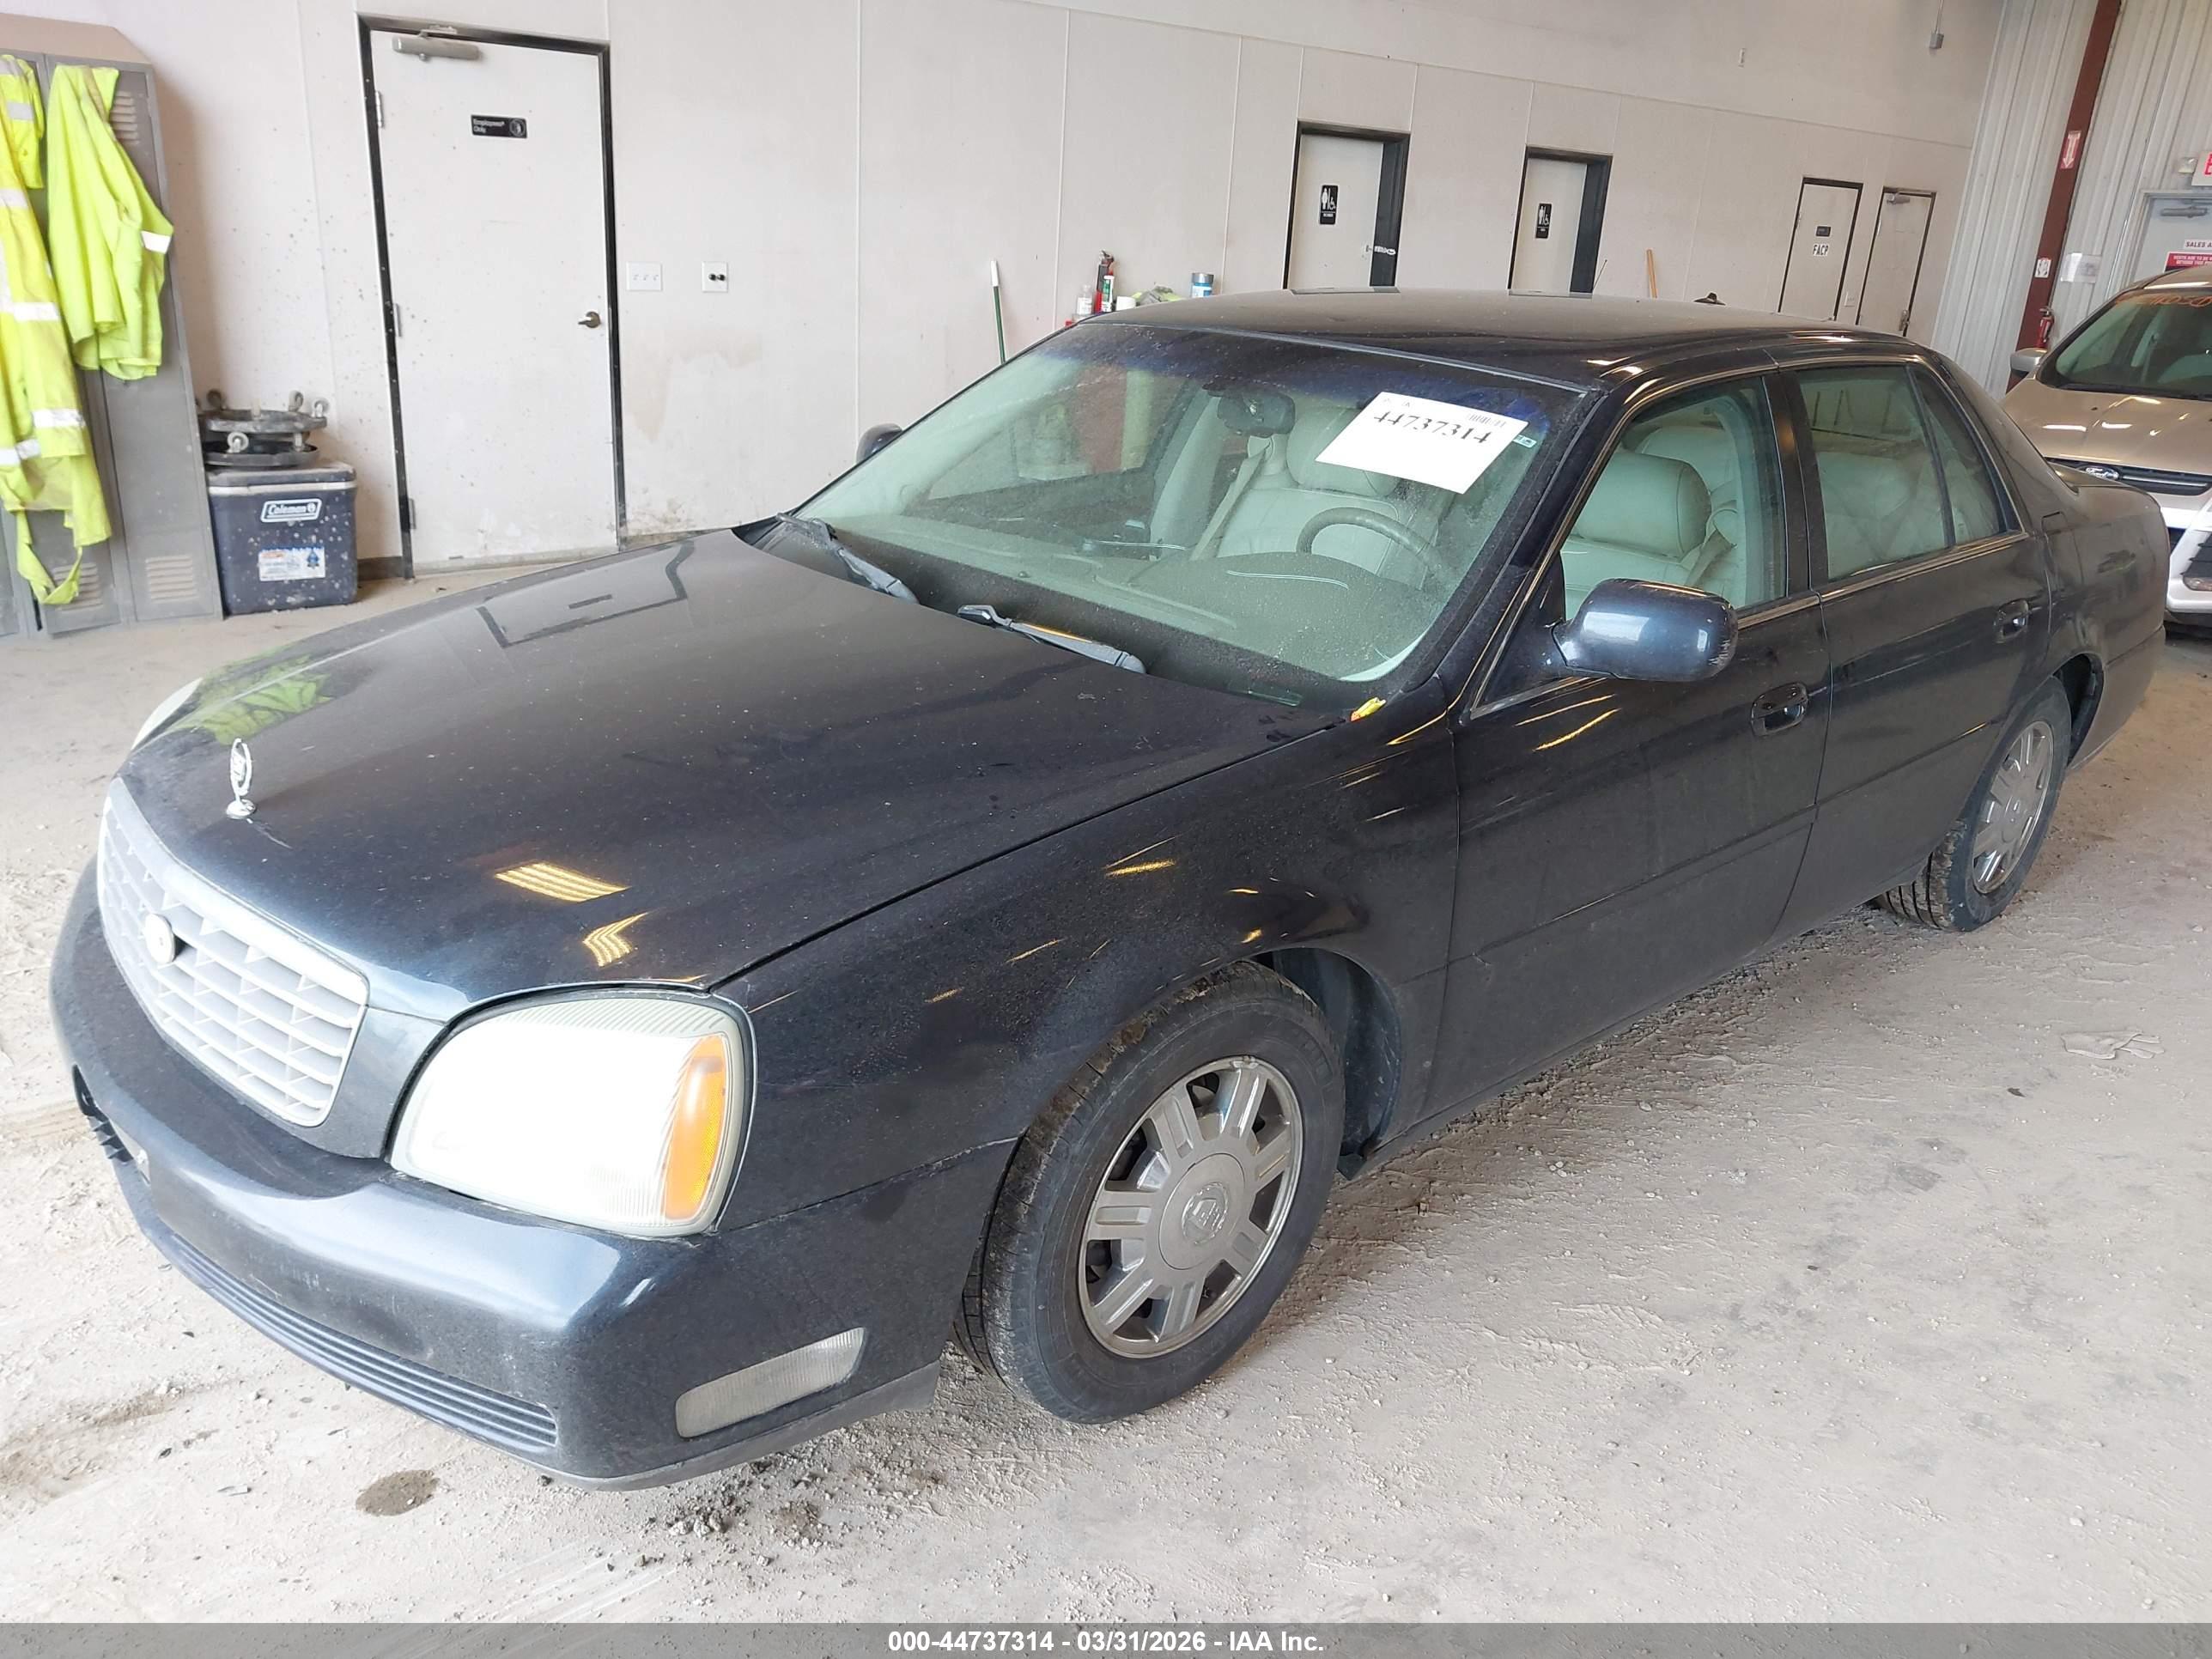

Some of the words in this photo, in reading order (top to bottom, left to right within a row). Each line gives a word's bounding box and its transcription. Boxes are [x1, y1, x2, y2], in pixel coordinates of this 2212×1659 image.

[1813, 244, 1829, 256] FACP
[1374, 410, 1492, 444] 44737314
[268, 503, 307, 515] Coleman
